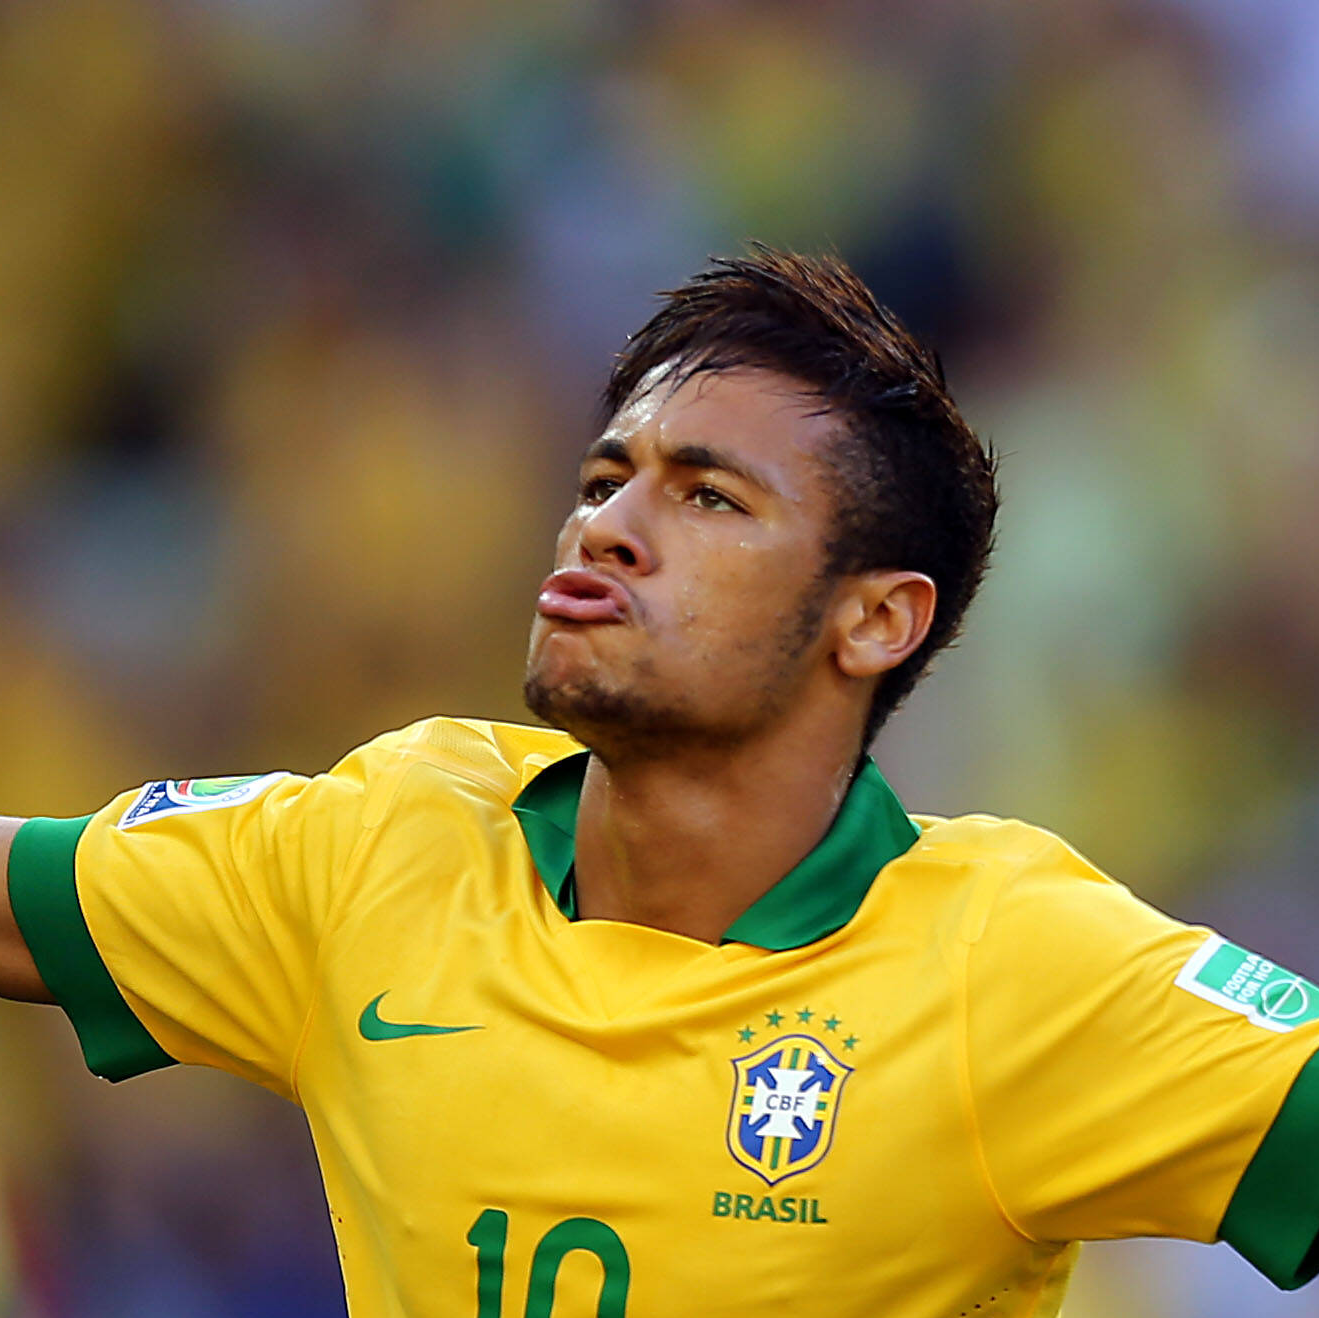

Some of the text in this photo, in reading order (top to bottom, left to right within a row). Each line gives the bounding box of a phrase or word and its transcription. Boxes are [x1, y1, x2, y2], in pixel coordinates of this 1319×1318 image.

[1236, 979, 1261, 1004] FOR
[766, 1094, 805, 1112] CBF
[712, 1191, 828, 1224] BRASIL
